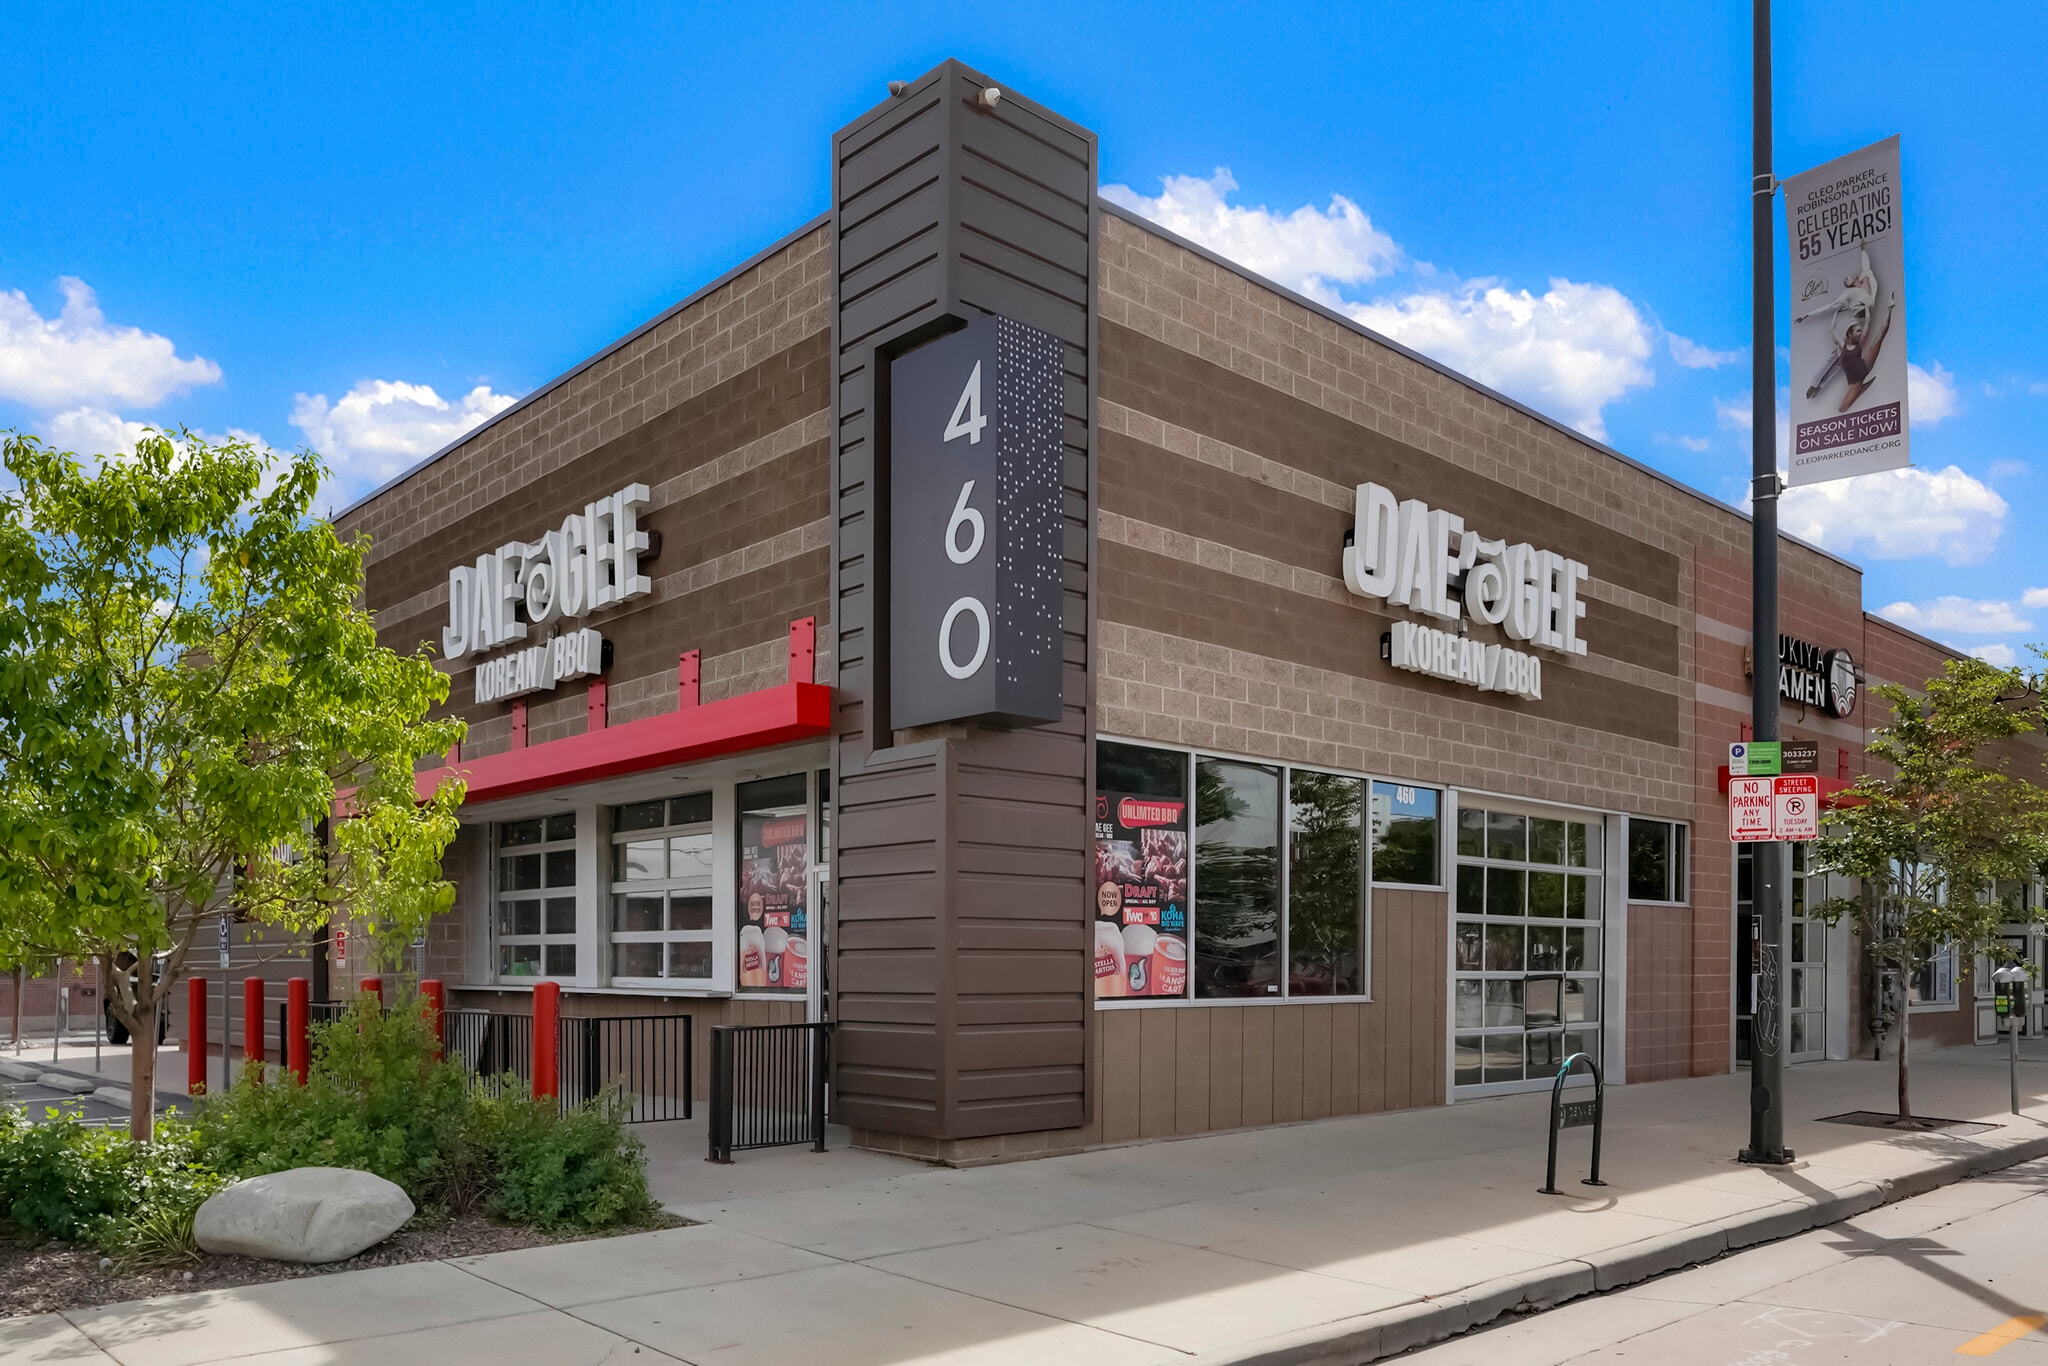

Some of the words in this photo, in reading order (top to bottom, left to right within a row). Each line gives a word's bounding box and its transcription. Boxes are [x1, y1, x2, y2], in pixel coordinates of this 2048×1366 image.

[1808, 184, 1834, 201] CLEO
[1837, 168, 1875, 191] PARKER
[1797, 187, 1849, 215] ROBINSON
[1852, 172, 1888, 195] DANCE
[1797, 186, 1891, 237] CELEBRATING
[1799, 233, 1822, 261] 55
[1826, 206, 1892, 250] YEARS!
[1799, 419, 1847, 438] SEASON
[1849, 407, 1898, 427] TICKETS
[1799, 437, 1820, 450] ON
[1823, 429, 1855, 445] SALE
[1858, 420, 1898, 438] NOW!
[1795, 440, 1902, 466] CLEOPARKERDANCE.ORG
[1778, 633, 1825, 673] UKIYA
[1779, 665, 1826, 708] AMEN
[1782, 750, 1817, 758] 3033237
[1396, 786, 1415, 805] 460
[1743, 781, 1759, 794] NO
[1778, 785, 1812, 793] SWEEPING
[1733, 795, 1770, 808] PARKING
[1161, 807, 1178, 824] BBQ
[1743, 808, 1760, 817] ANY
[1742, 817, 1762, 826] TIME
[1101, 891, 1118, 899] NOW
[1124, 883, 1158, 898] DRAFT
[1161, 911, 1184, 921] KONA
[1094, 957, 1115, 968] STELLA
[1162, 983, 1182, 993] CART
